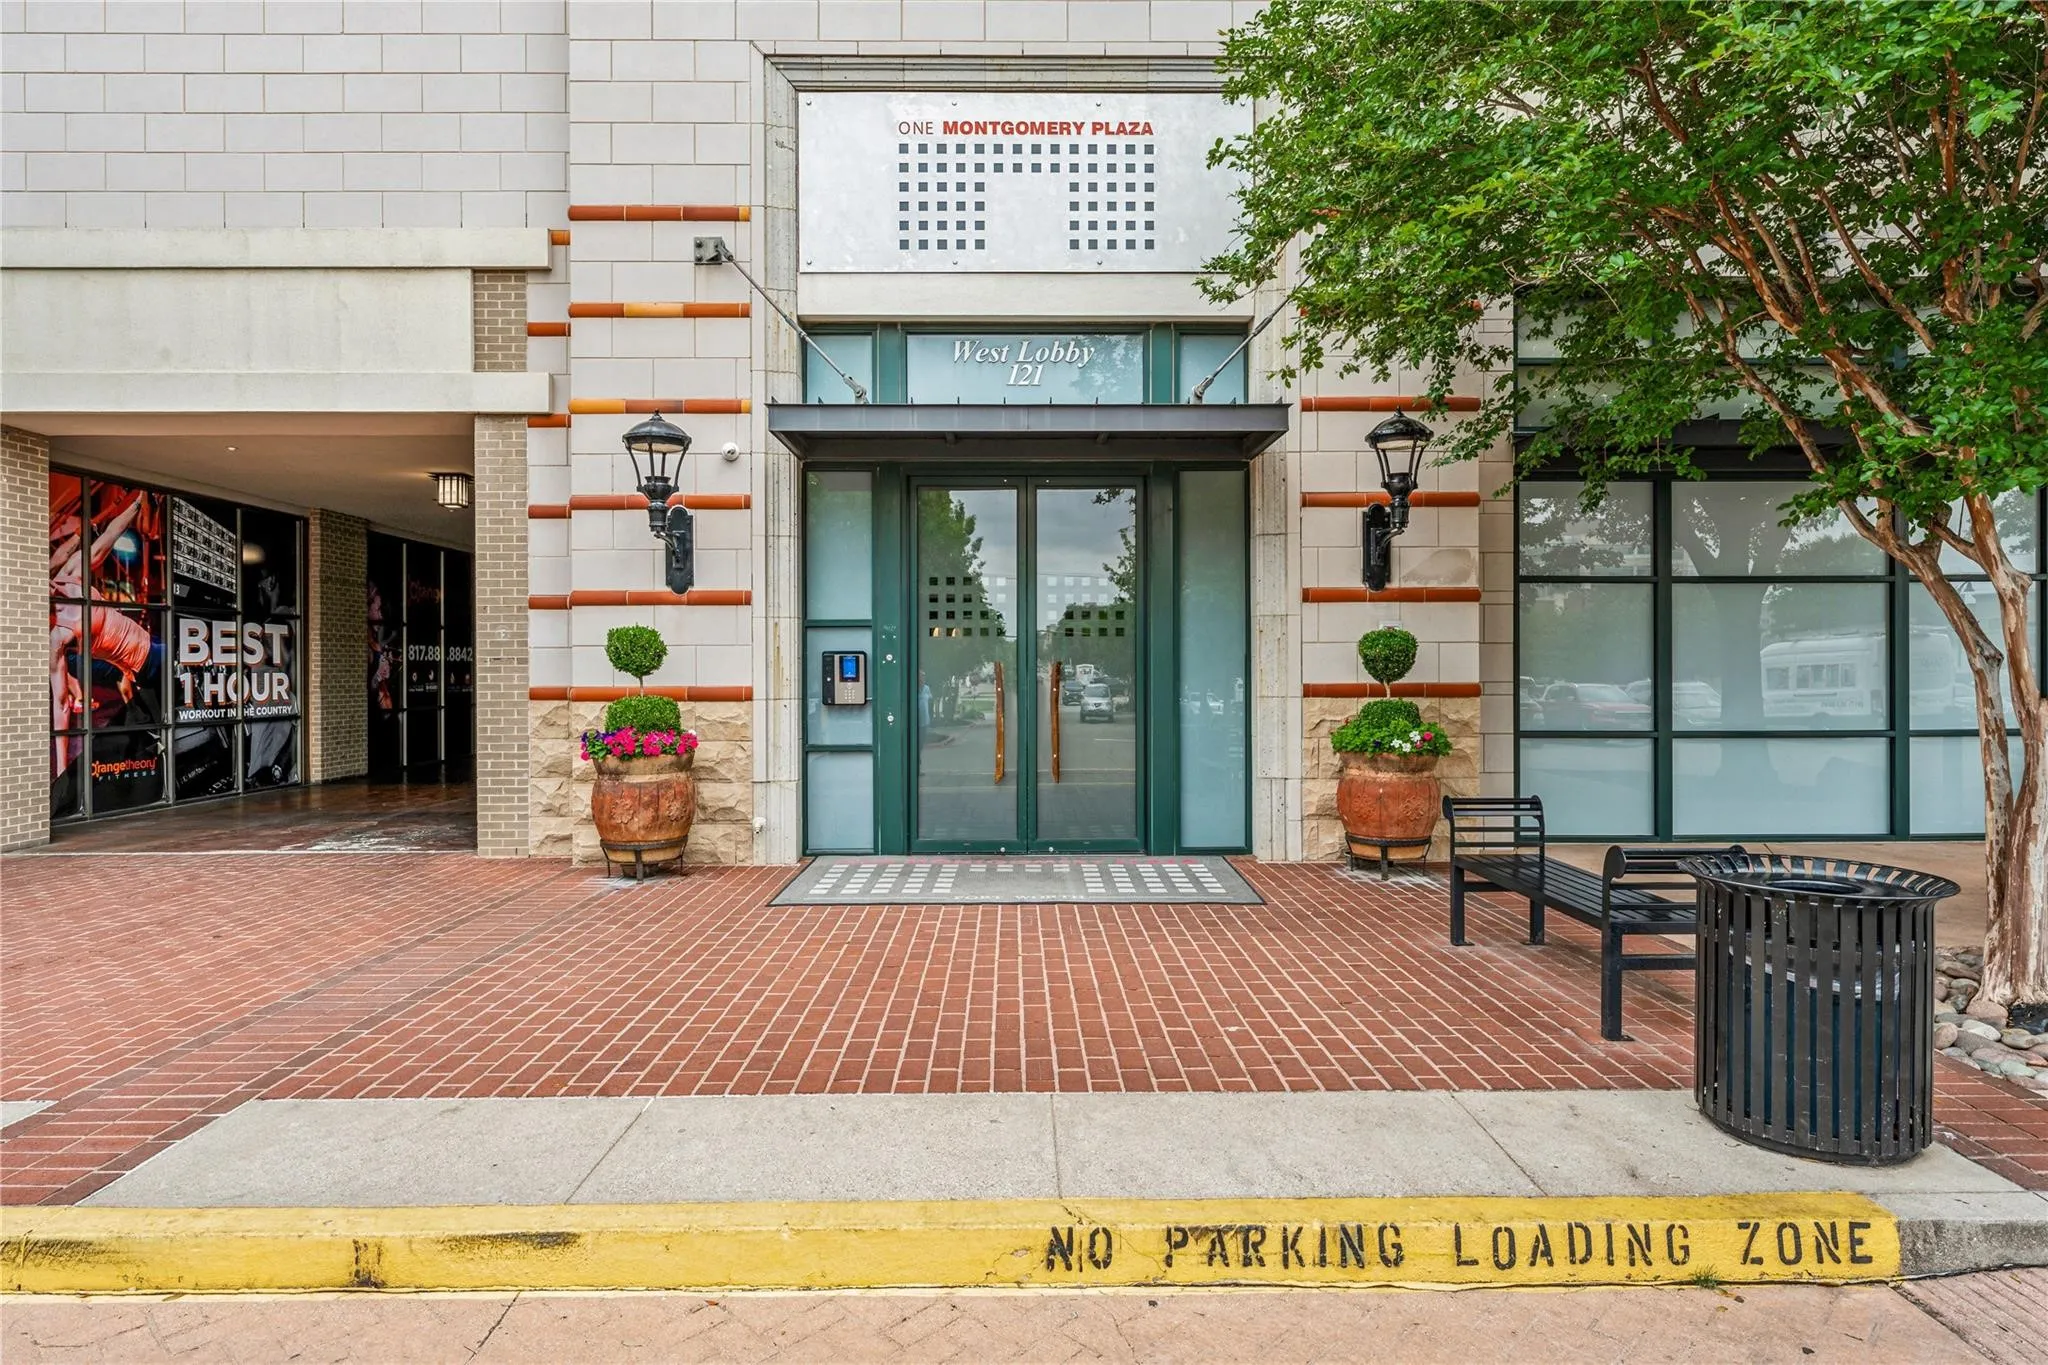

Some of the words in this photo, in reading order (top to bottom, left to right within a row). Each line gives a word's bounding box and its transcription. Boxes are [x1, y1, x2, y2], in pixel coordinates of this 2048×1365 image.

[898, 121, 934, 135] ONE
[942, 120, 1086, 136] MONTGOMERY
[1091, 121, 1154, 136] PLAZA
[953, 340, 1010, 363] West
[1016, 340, 1095, 368] Lobby
[1006, 363, 1044, 386] 121
[179, 618, 289, 667] BEST
[180, 671, 194, 707] 1
[203, 671, 290, 707] HOUR
[179, 708, 226, 720] WORKOUT
[227, 708, 237, 718] IN
[240, 706, 255, 717] HE
[256, 705, 293, 715] COUNTRY
[1046, 1225, 1113, 1272] NO
[1165, 1222, 1404, 1269] PARKING
[1453, 1222, 1691, 1270] LOADING
[1737, 1221, 1874, 1266] ZONE
